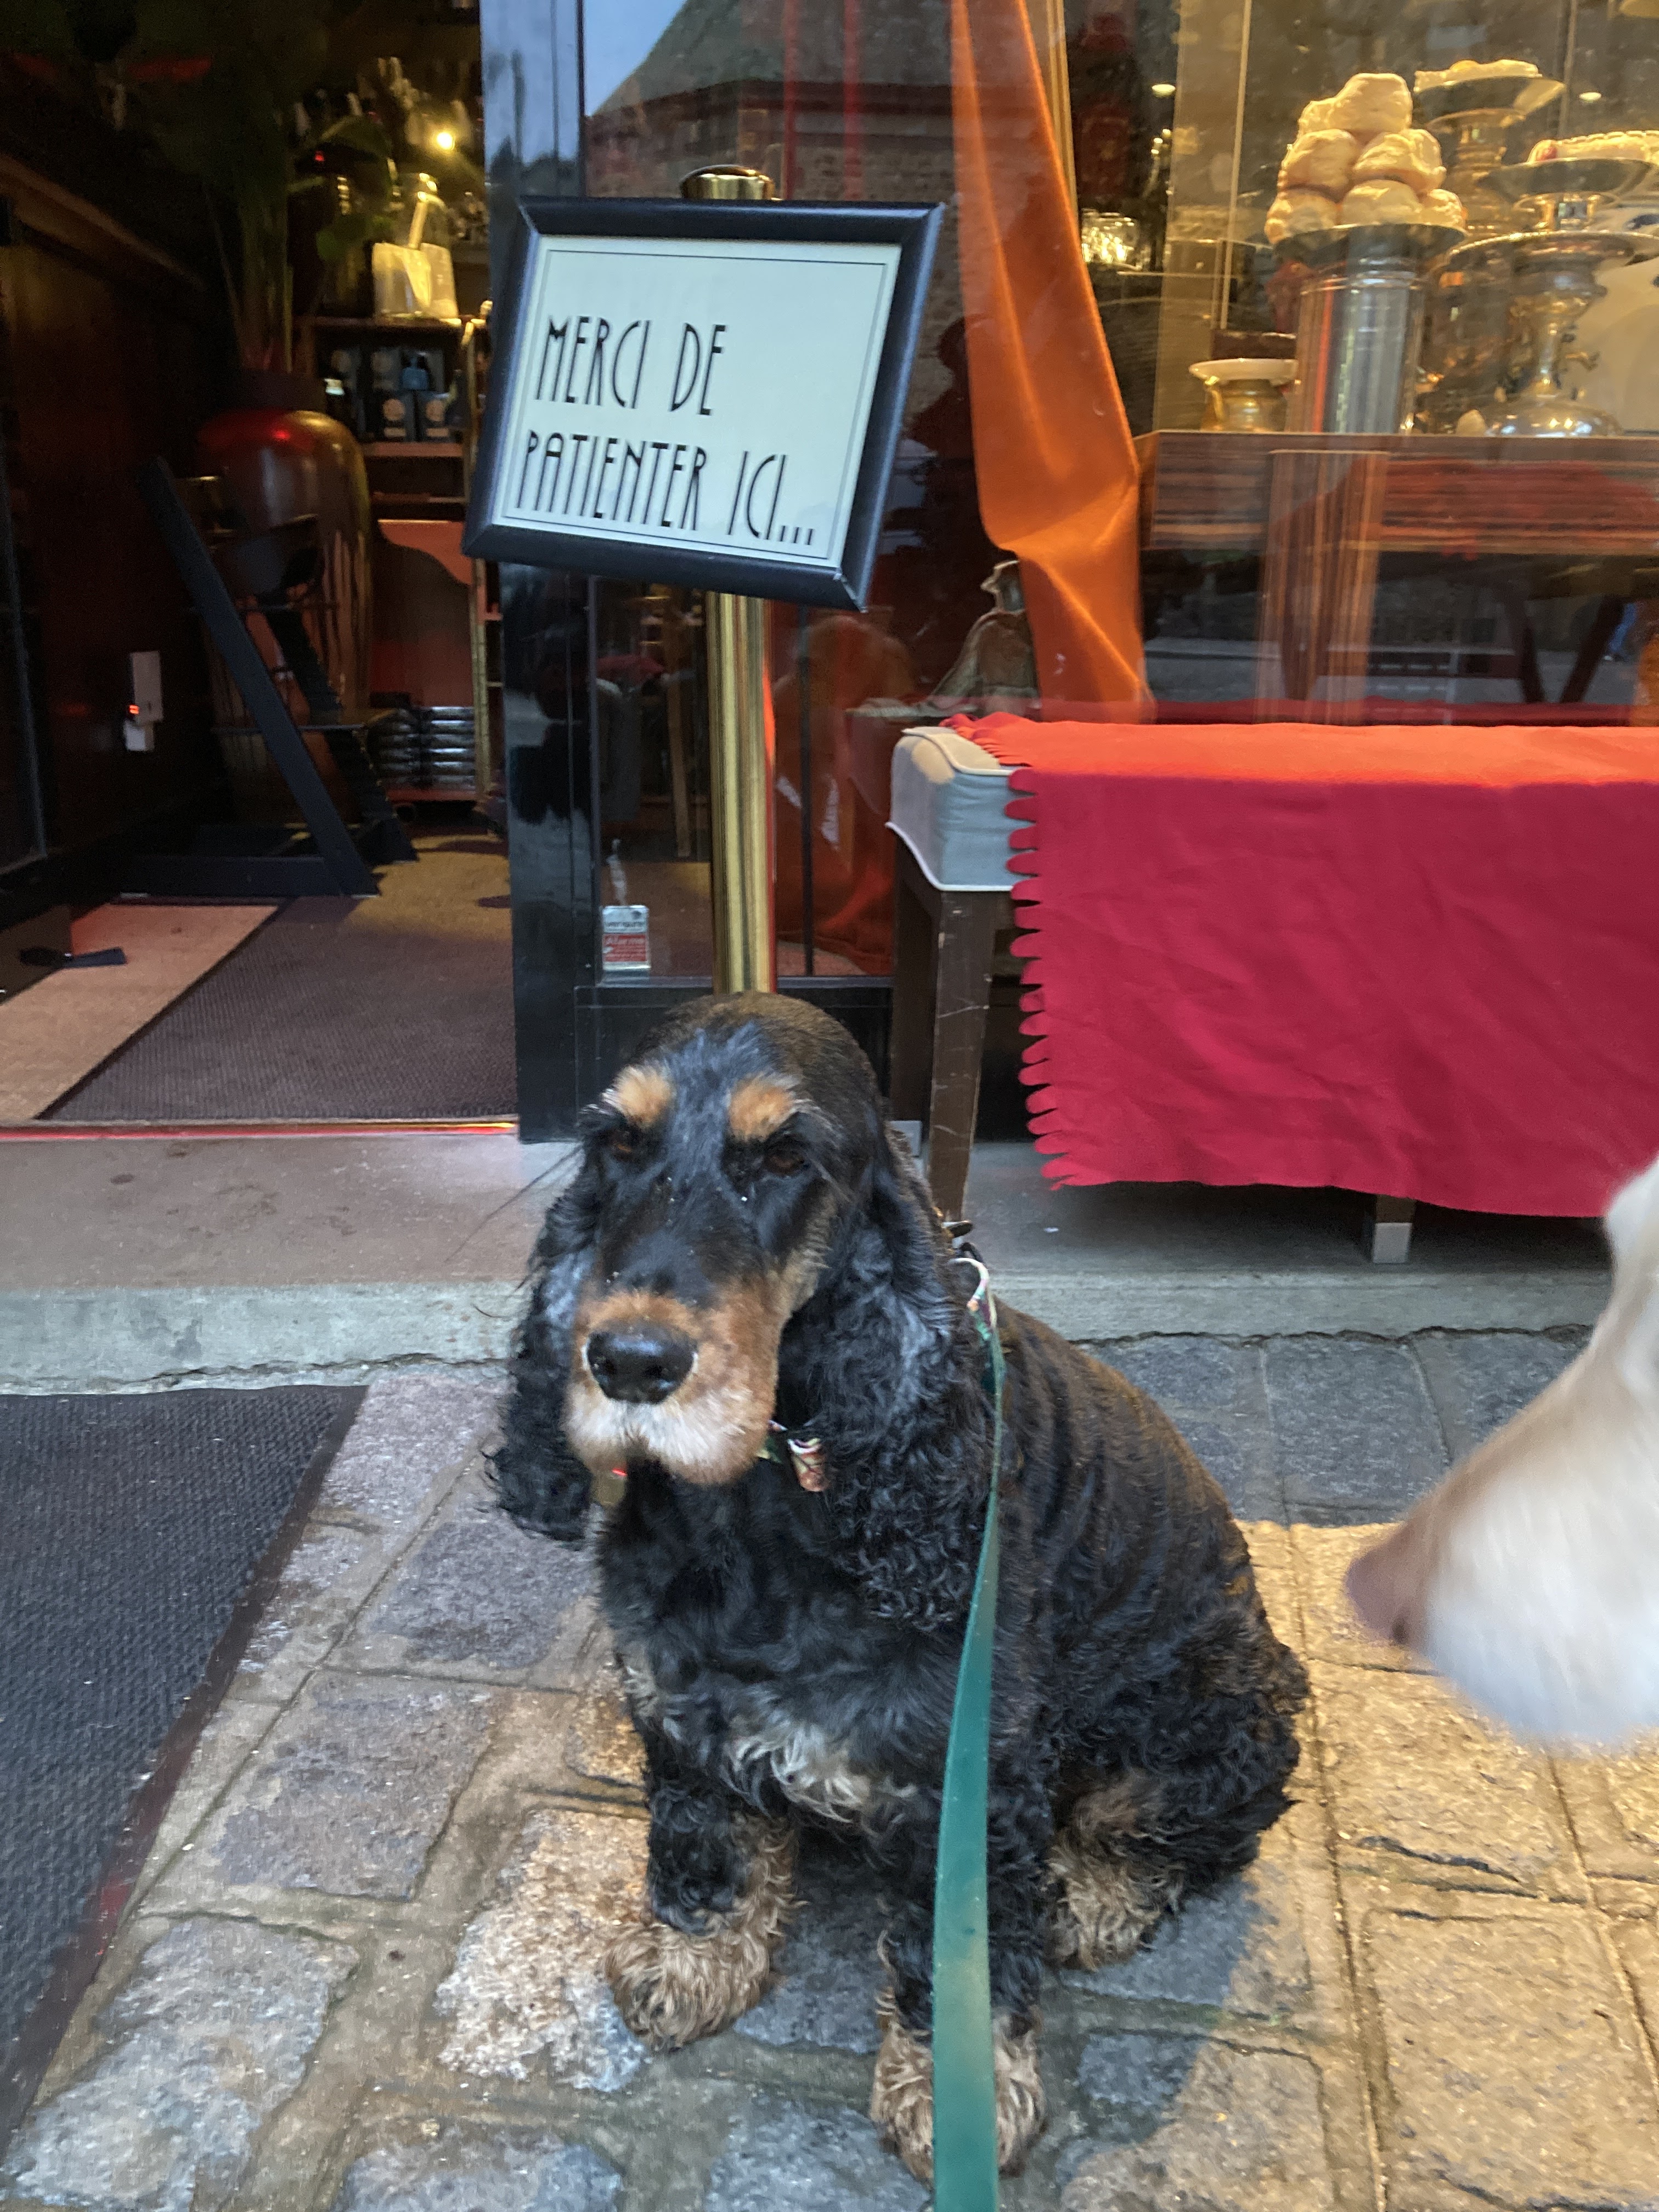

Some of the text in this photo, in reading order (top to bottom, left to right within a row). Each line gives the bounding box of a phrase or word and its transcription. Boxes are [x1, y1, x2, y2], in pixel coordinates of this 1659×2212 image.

[534, 316, 727, 416] MERCI DE
[515, 431, 814, 545] PATIENTER ICI...
